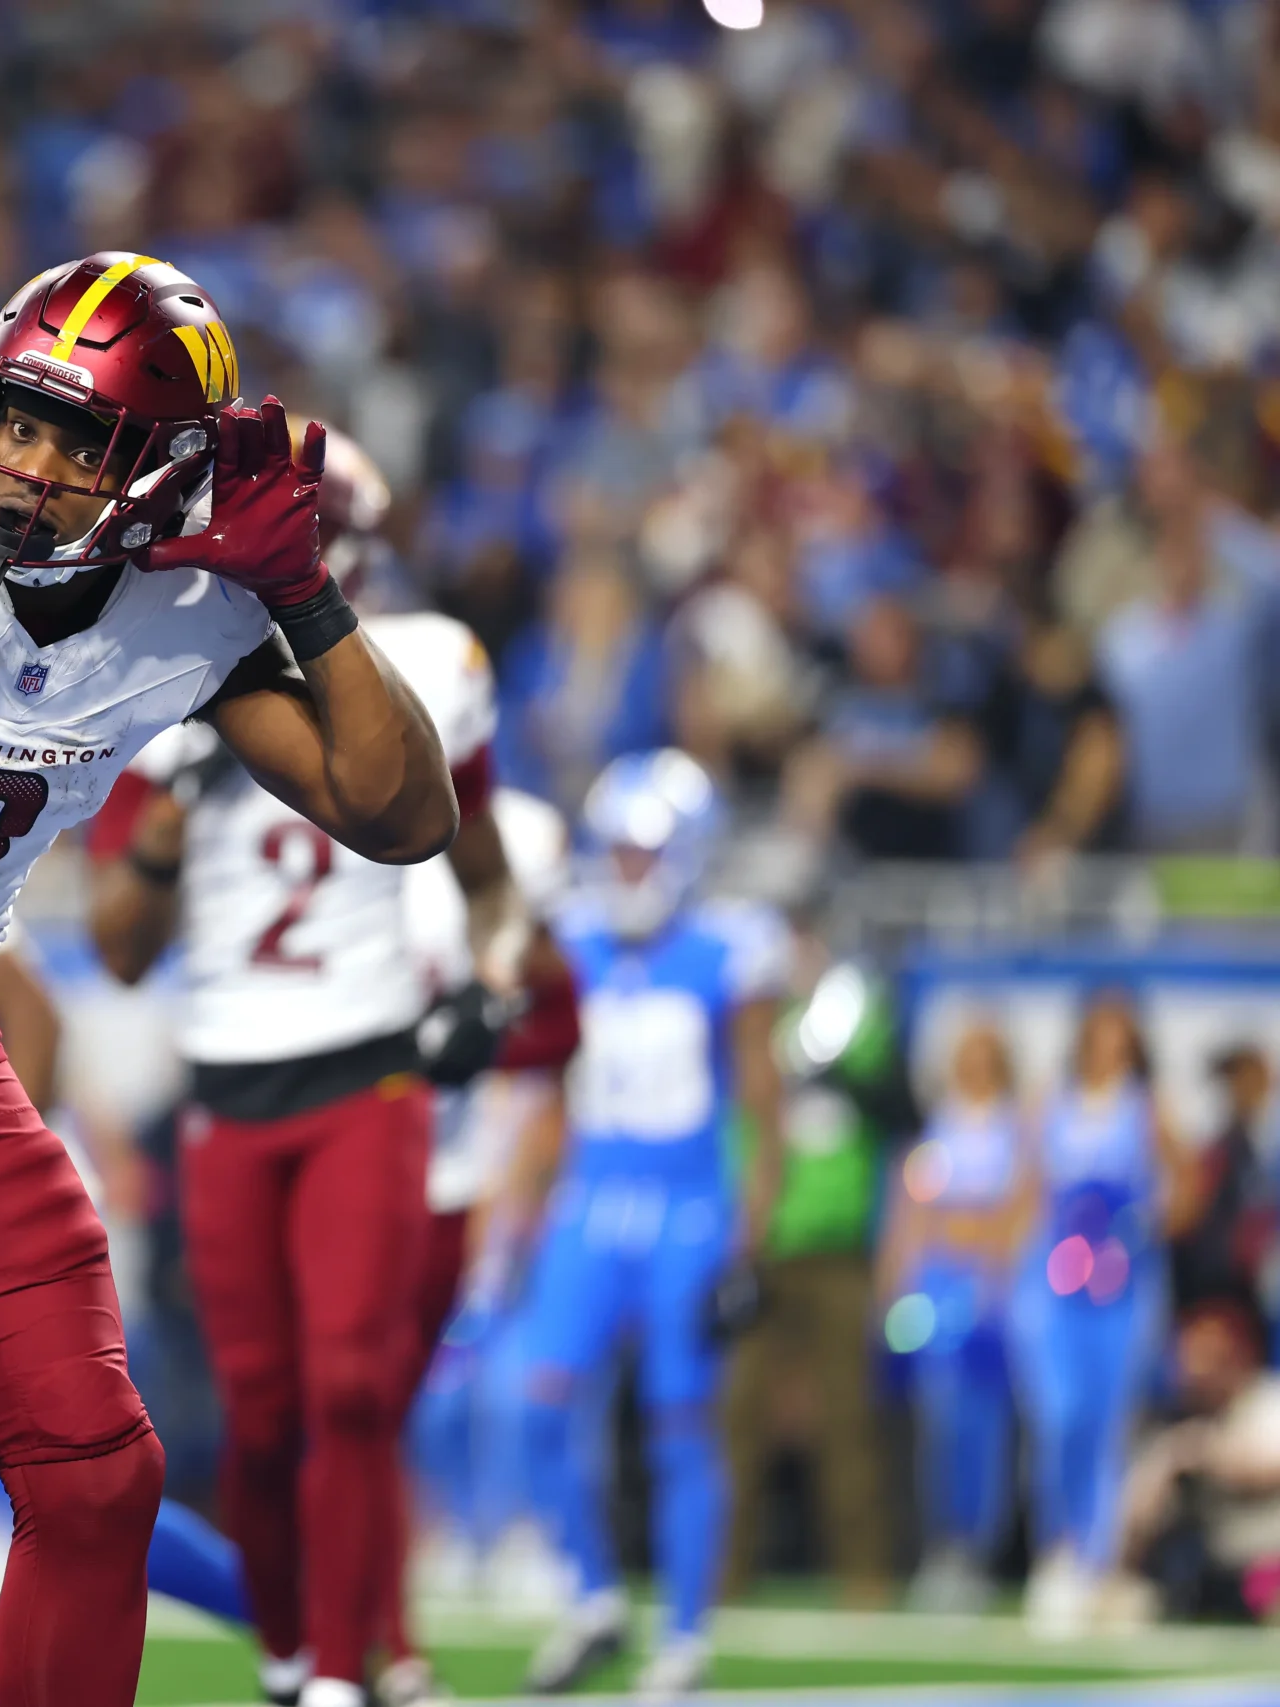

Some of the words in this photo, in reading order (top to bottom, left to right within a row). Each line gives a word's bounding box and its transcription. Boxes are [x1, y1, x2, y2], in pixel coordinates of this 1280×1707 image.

[22, 356, 82, 384] COMMANDERS
[21, 677, 41, 692] NFL
[250, 820, 334, 972] 2
